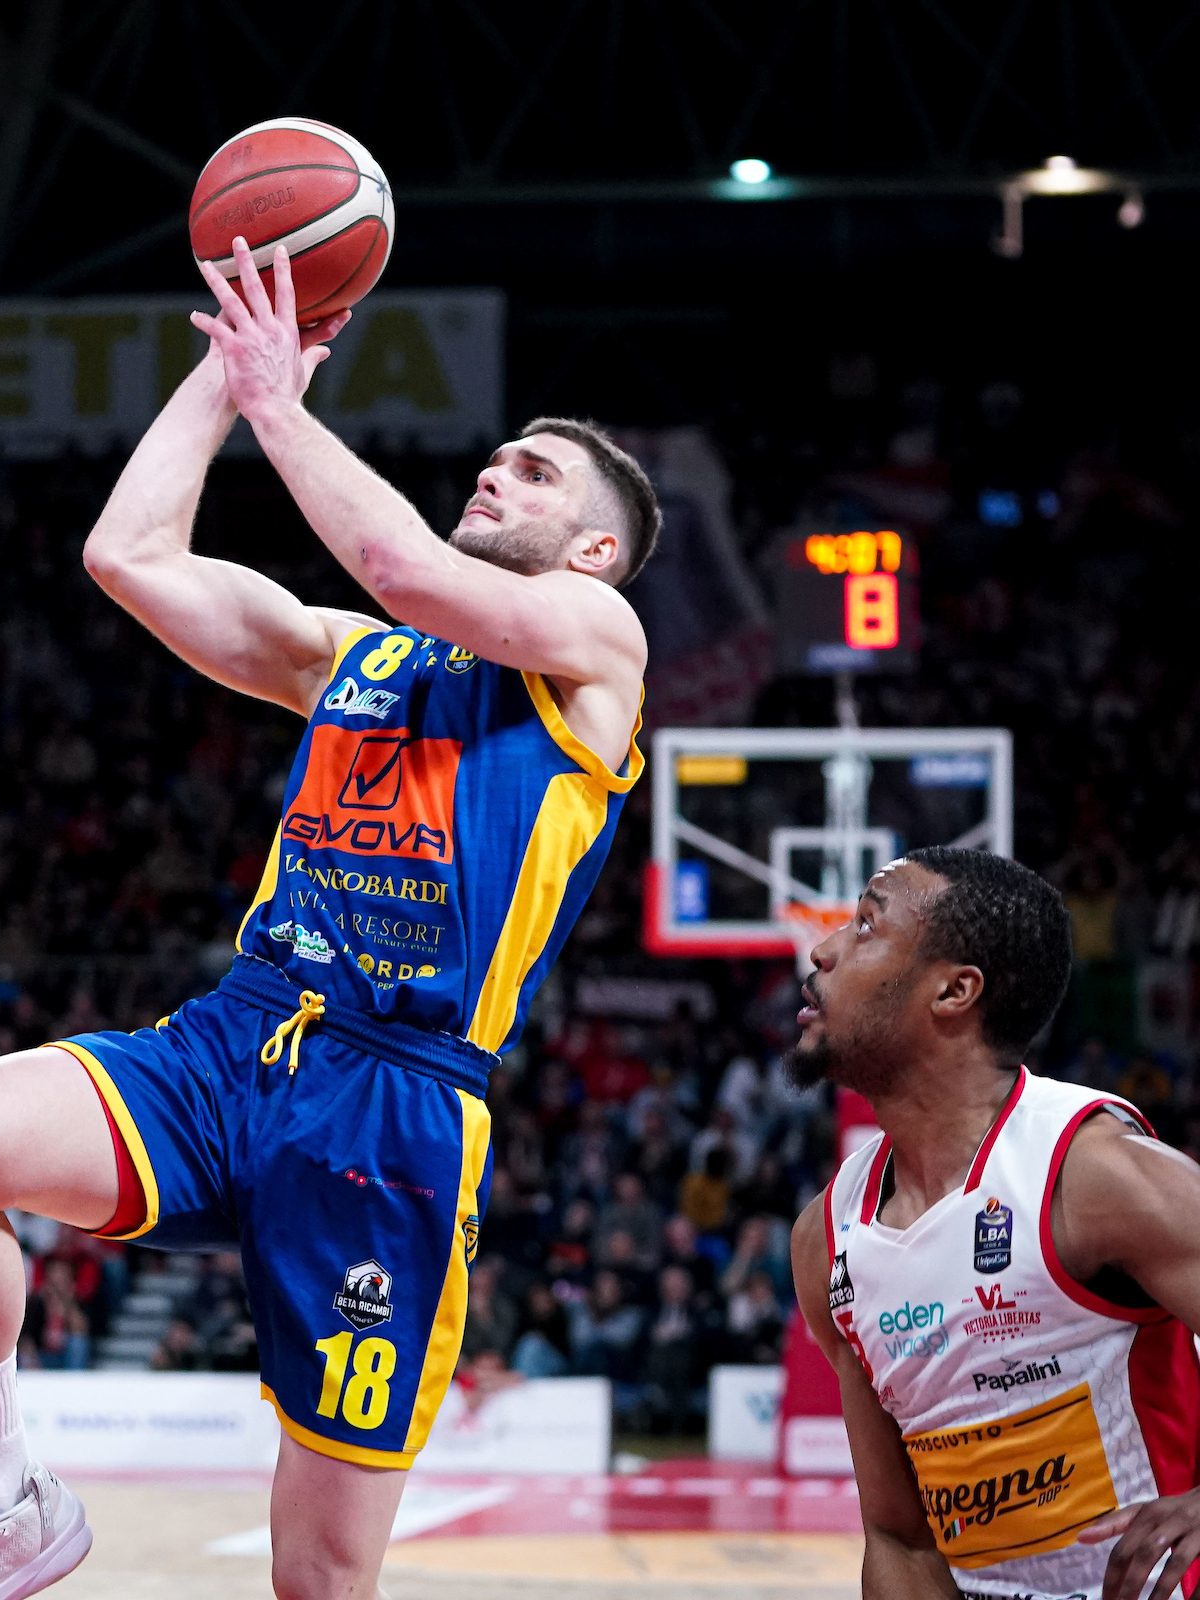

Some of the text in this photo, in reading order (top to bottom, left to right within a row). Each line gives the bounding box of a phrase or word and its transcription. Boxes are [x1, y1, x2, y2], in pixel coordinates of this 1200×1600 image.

[844, 572, 898, 649] 8
[352, 913, 446, 945] RESORT
[373, 936, 438, 953] luxury event
[979, 1227, 1008, 1242] LBA
[337, 1295, 390, 1317] BETA RICAMBI
[975, 1284, 1016, 1311] VL
[879, 1301, 944, 1334] eden
[963, 1311, 1041, 1336] VICTORIA LIBERTAS
[315, 1331, 397, 1430] 18
[973, 1355, 1062, 1392] Papalini
[1037, 1487, 1062, 1508] DOP
